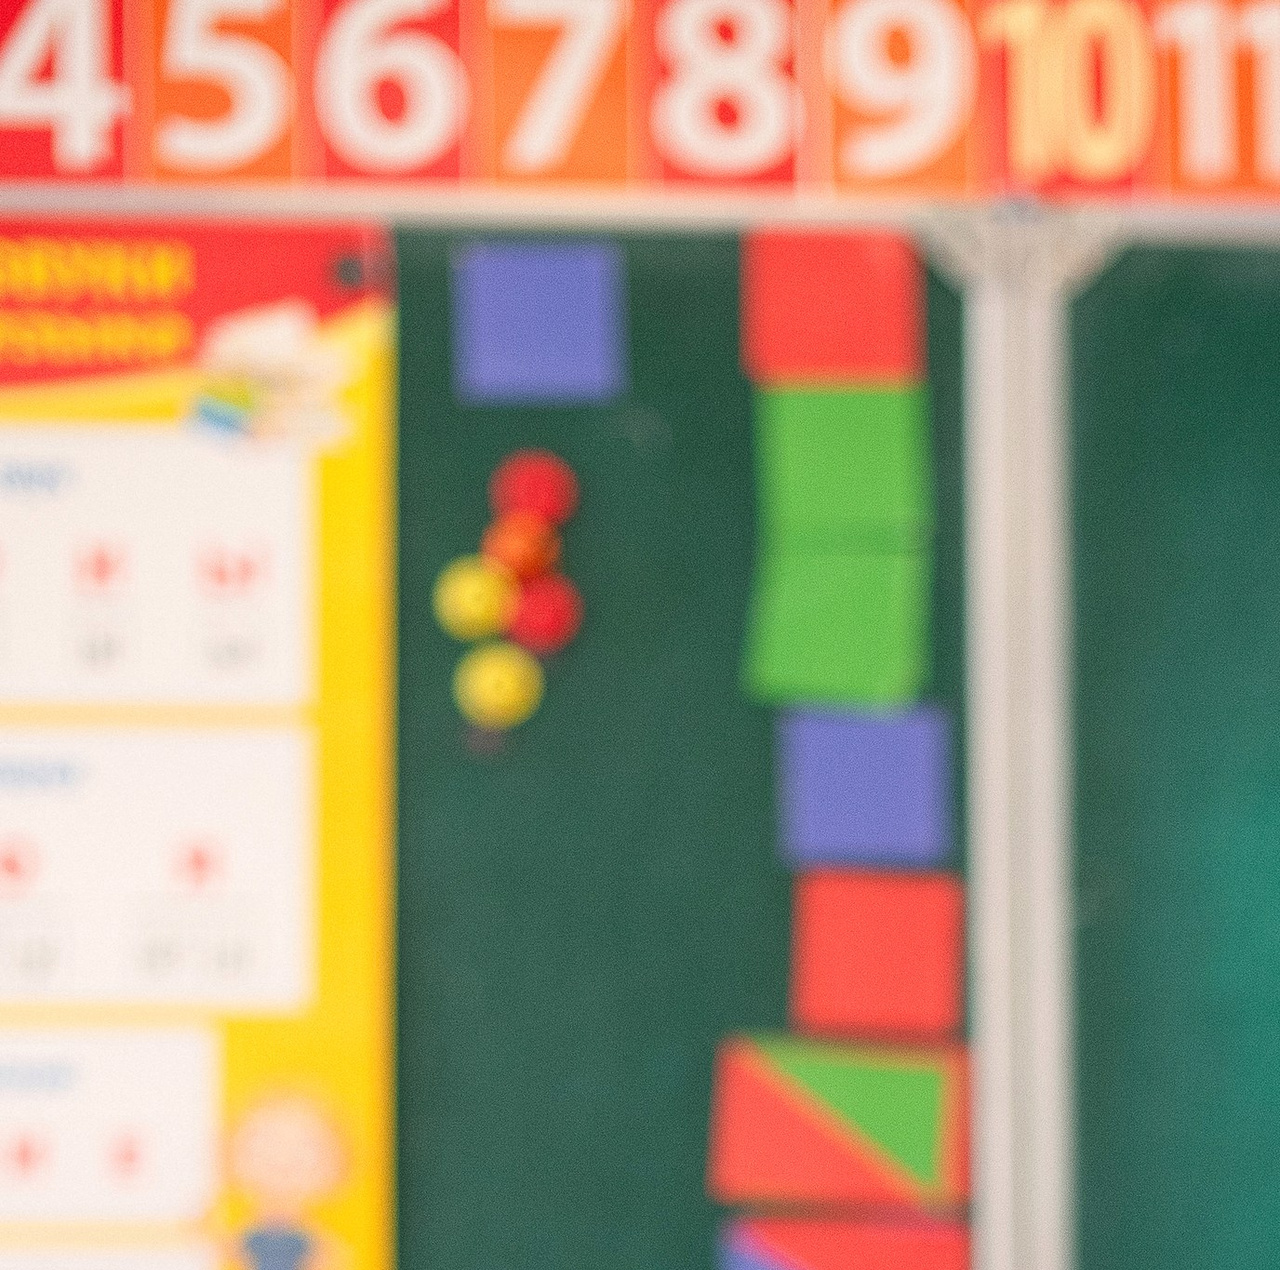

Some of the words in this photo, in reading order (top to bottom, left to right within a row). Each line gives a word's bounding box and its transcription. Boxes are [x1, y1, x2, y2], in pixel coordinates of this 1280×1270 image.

[0, 0, 132, 172] 4
[152, 0, 294, 172] 5
[314, 0, 470, 174] 6
[487, 0, 634, 175] 7
[652, 0, 805, 177] 8
[823, 0, 976, 177] 9
[984, 0, 1157, 178] 10
